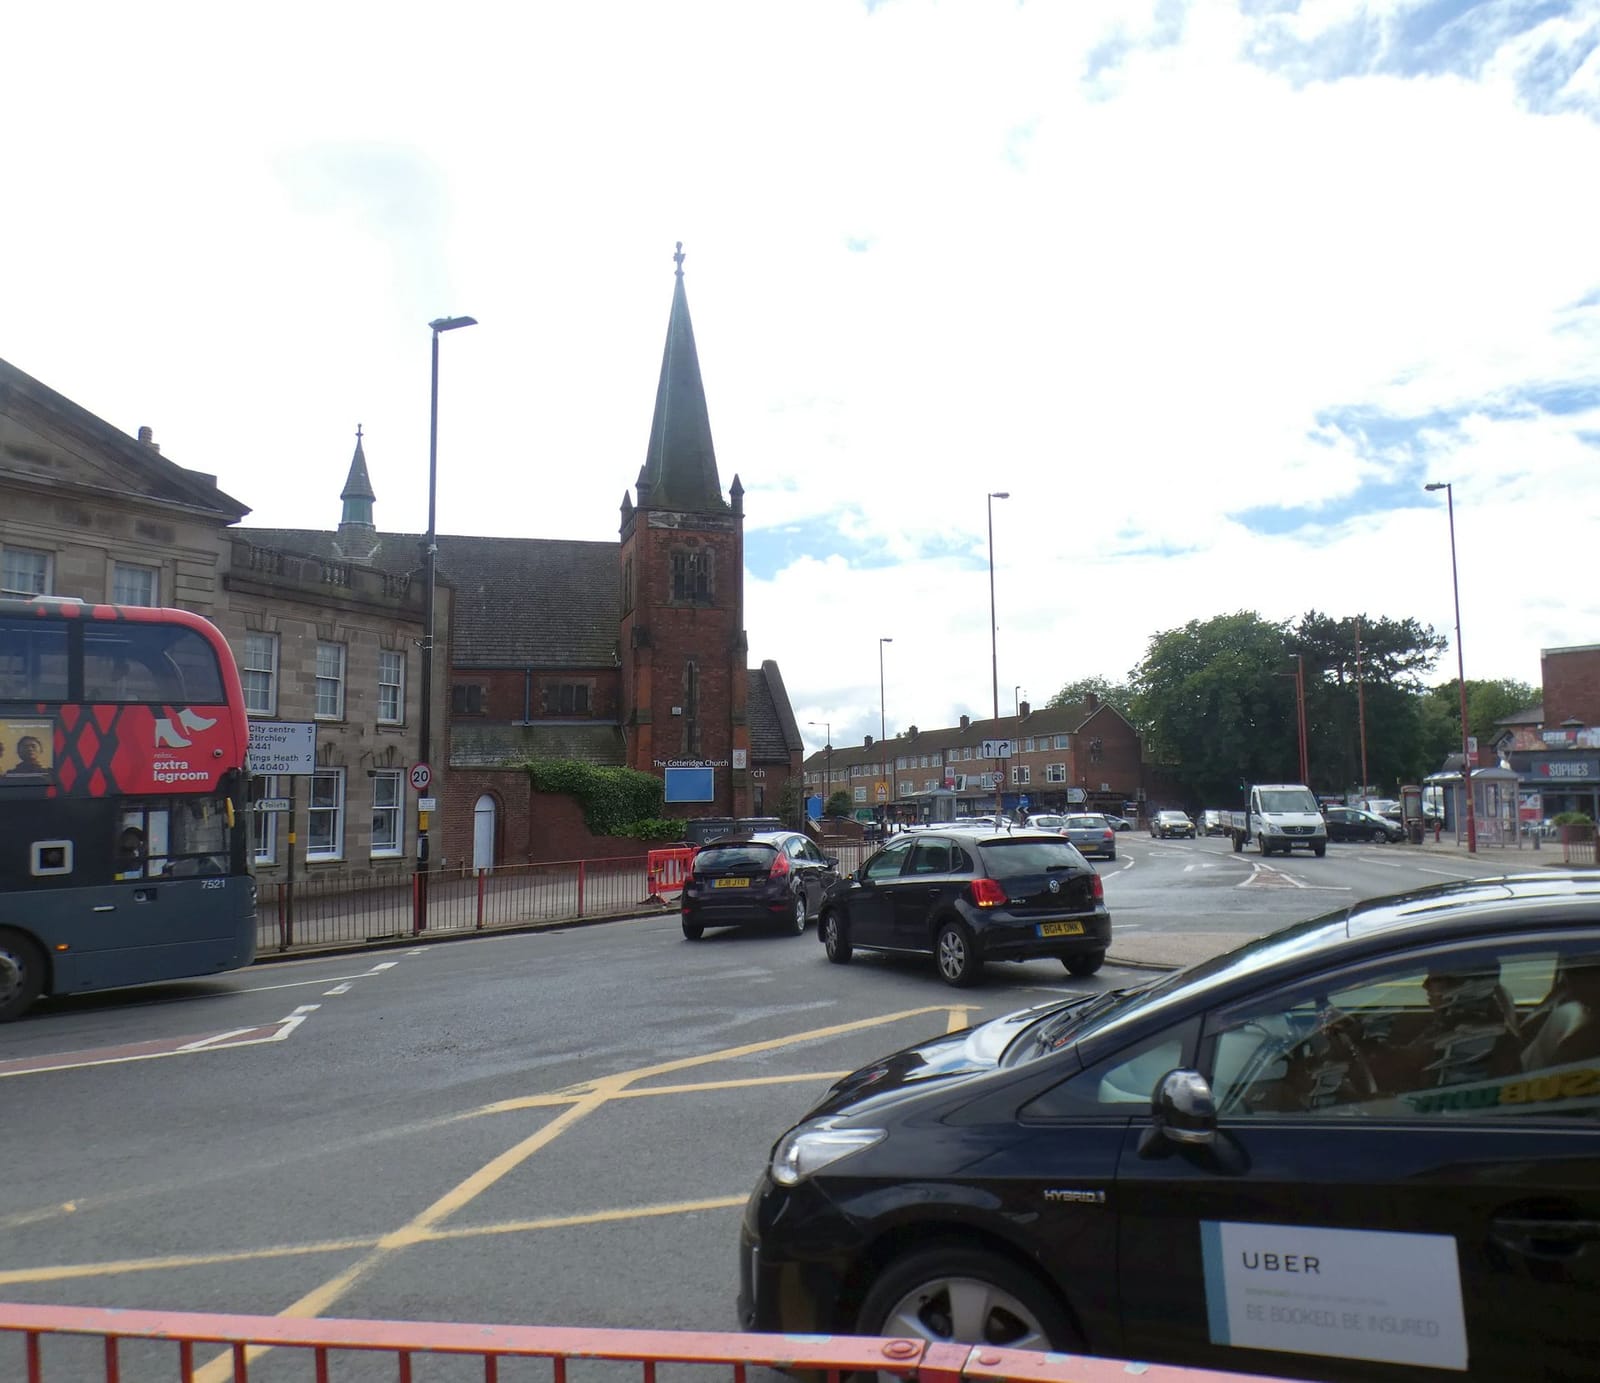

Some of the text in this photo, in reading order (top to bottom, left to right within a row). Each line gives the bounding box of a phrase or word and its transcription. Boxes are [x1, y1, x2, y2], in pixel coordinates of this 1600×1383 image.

[248, 725, 313, 734] City centre 5
[248, 734, 287, 743] Stirchley
[306, 754, 312, 762] 2
[153, 760, 189, 770] extra
[667, 760, 704, 768] Cotteridge
[1549, 762, 1588, 776] SOPHIES
[153, 770, 209, 784] legroom
[413, 770, 429, 782] 20
[201, 879, 225, 889] 7521
[1242, 1252, 1321, 1275] UBER
[1245, 1303, 1266, 1322] BE
[1341, 1311, 1362, 1331] BE
[1368, 1315, 1441, 1338] INSURED
